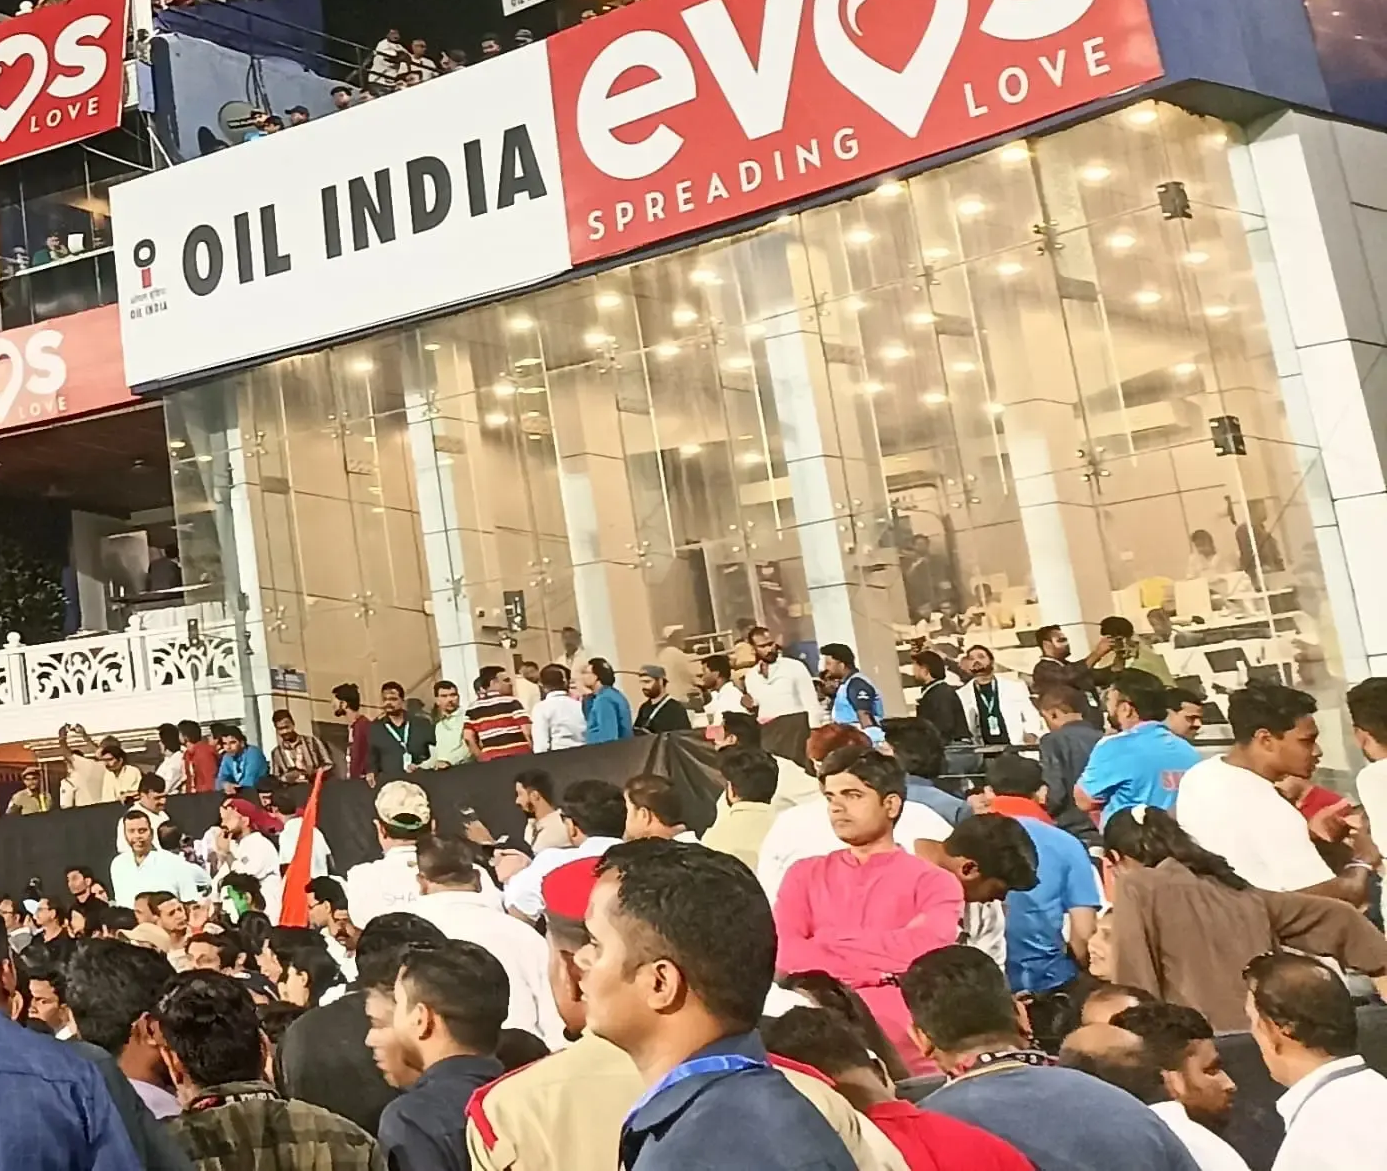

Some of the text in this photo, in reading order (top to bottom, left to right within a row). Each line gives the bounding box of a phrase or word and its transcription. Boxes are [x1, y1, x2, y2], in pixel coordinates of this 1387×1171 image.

[29, 96, 100, 134] LOVE
[587, 36, 1111, 241] SPREADING LOVE
[182, 124, 548, 297] OIL INDIA
